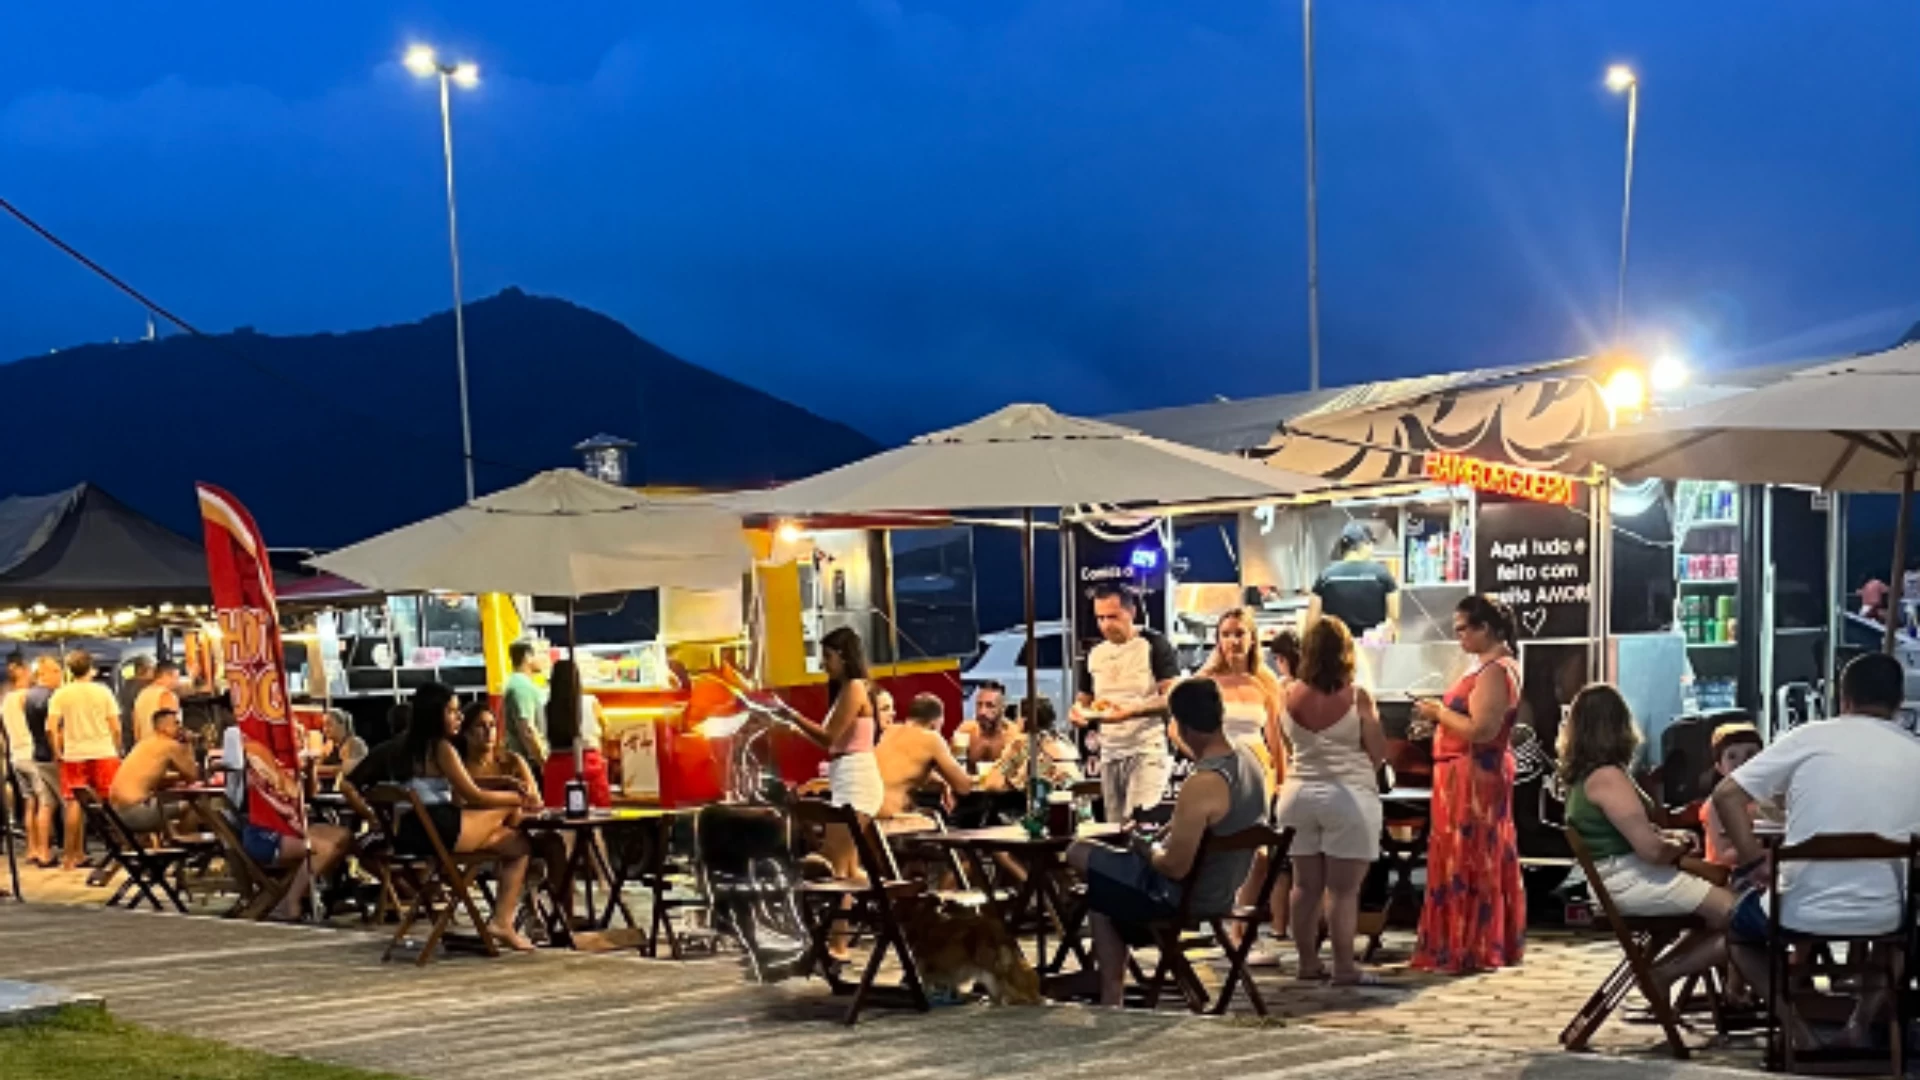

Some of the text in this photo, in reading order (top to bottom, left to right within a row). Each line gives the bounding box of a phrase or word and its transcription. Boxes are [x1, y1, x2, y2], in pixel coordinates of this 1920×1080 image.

[1489, 539, 1527, 561] Aqui
[1497, 563, 1579, 581] feito com
